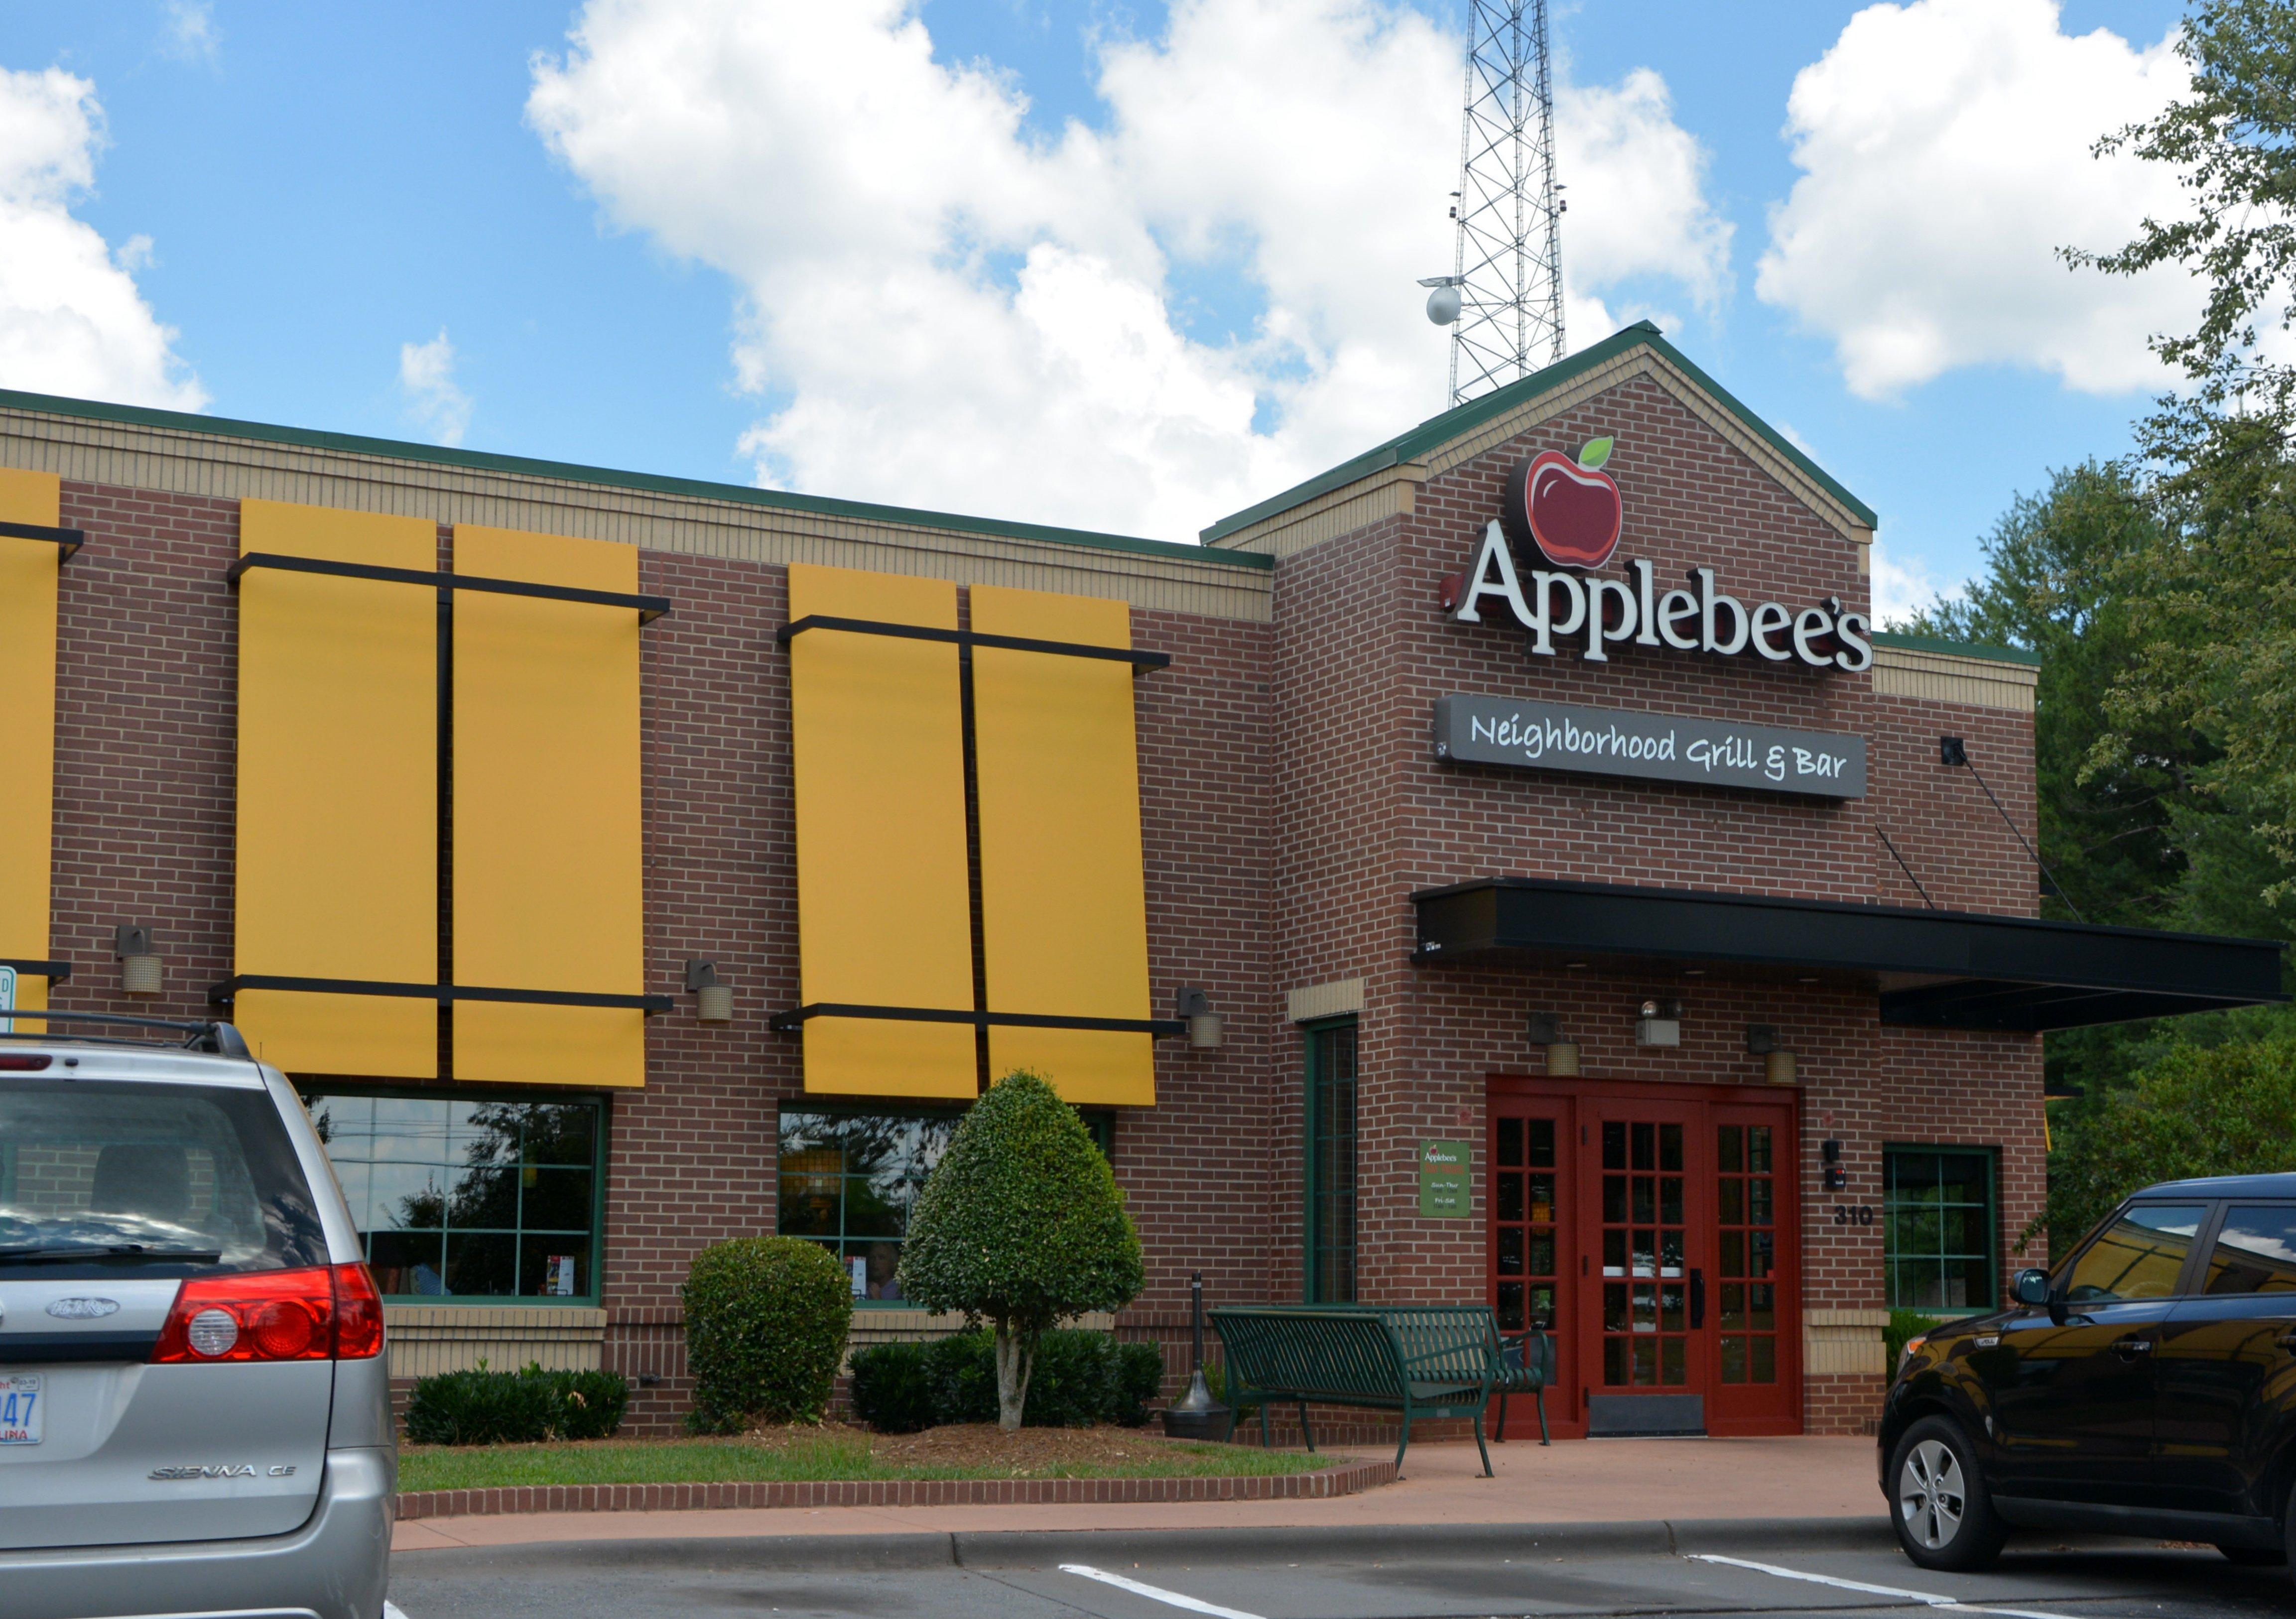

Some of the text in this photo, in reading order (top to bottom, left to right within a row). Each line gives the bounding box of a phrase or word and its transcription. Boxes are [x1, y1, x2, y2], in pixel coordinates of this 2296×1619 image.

[1457, 518, 1873, 671] Applebee's
[1472, 713, 1847, 781] Neighborhood Grill & Bar
[1834, 1205, 1873, 1226] 310
[0, 1393, 36, 1427] 47
[148, 1465, 296, 1480] SIENNA CE
